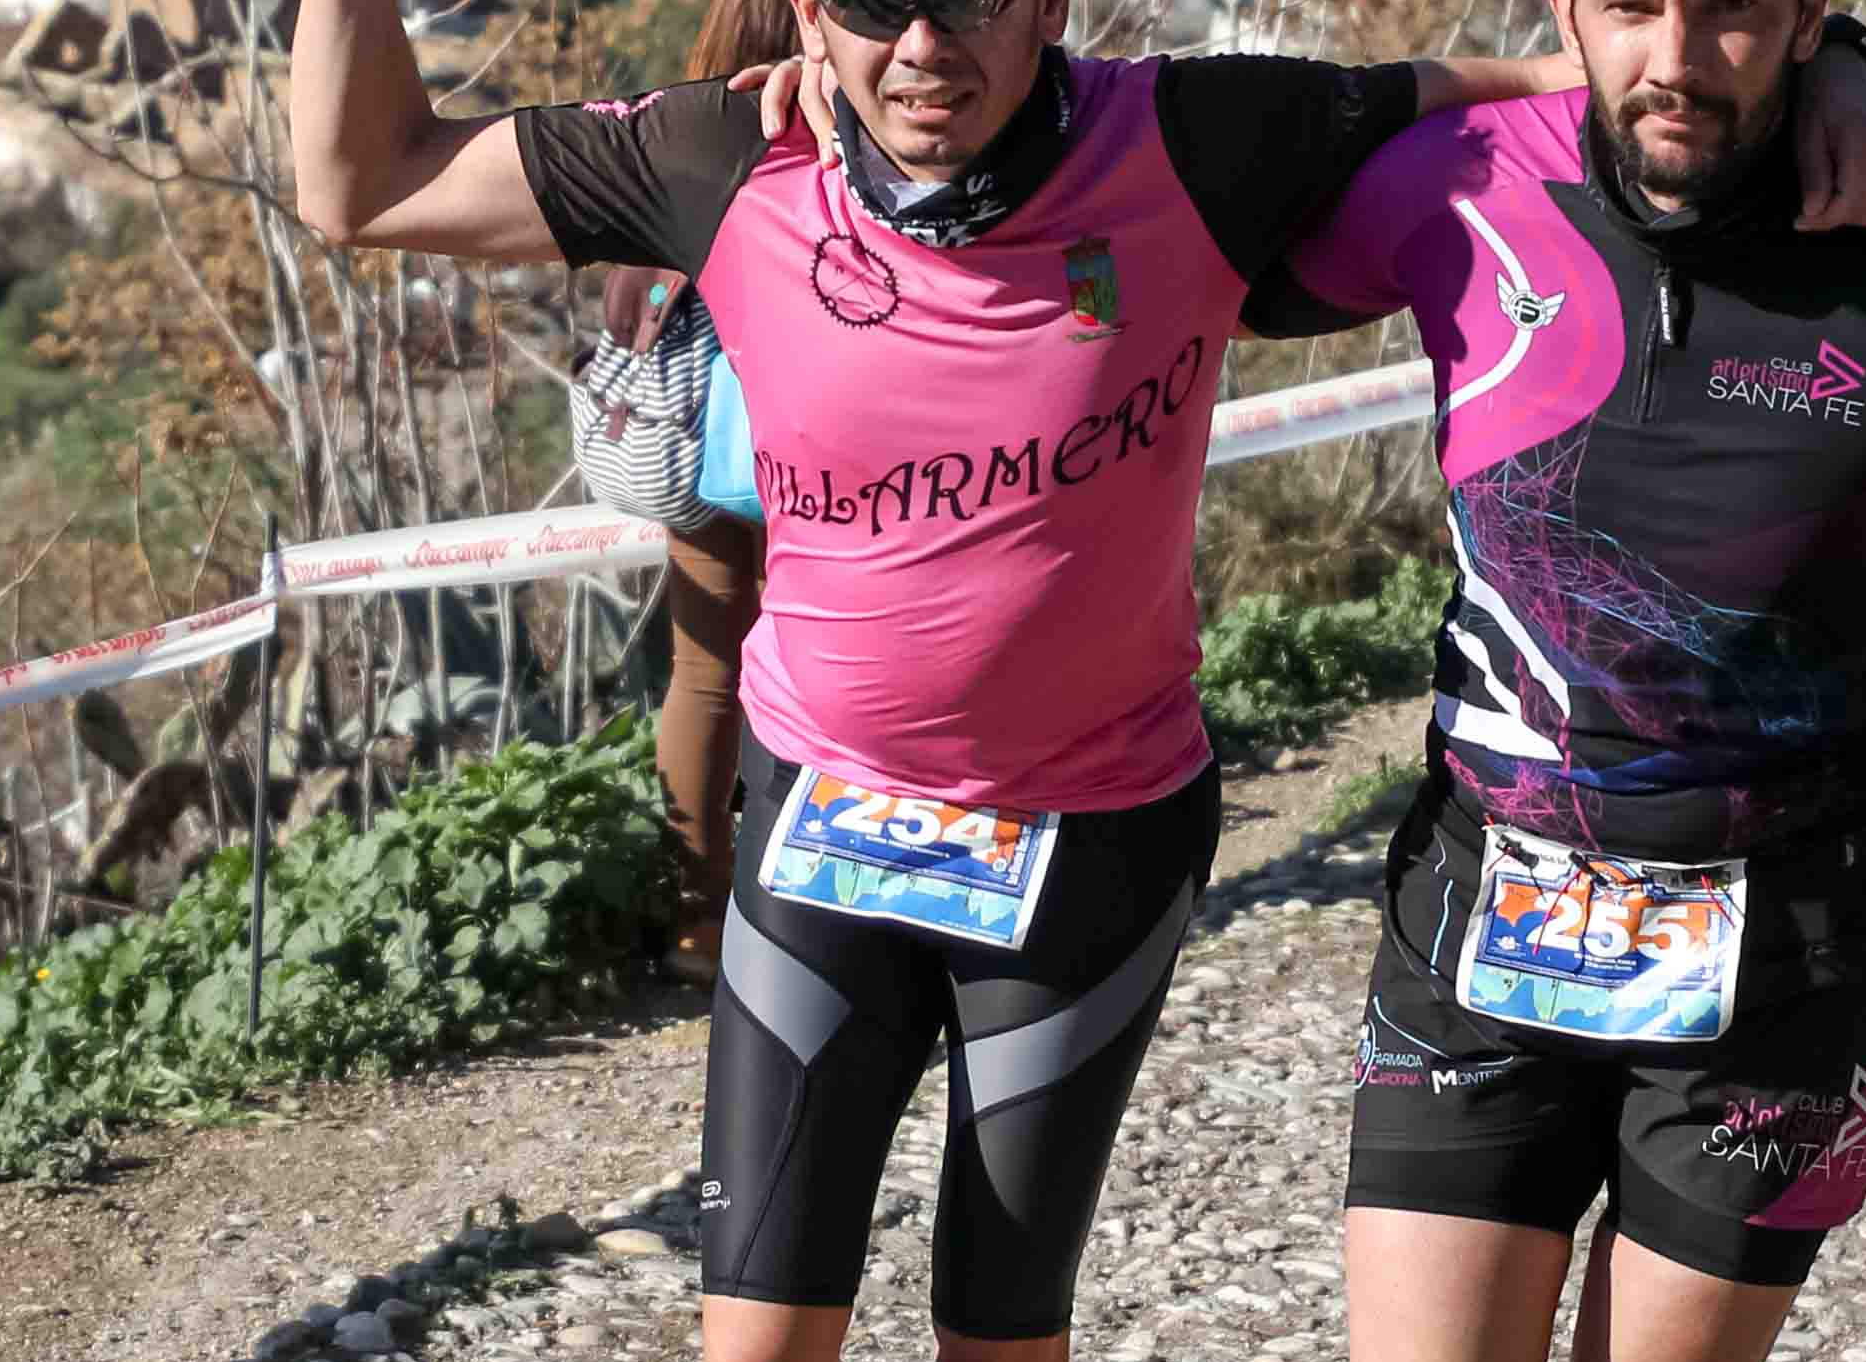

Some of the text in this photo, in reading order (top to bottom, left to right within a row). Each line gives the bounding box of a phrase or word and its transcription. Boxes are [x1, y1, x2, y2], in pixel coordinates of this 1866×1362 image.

[755, 336, 1203, 536] VILLARMERO
[1707, 376, 1865, 427] SANTA FE
[830, 785, 998, 864] 254
[1525, 889, 1694, 961] 255
[1702, 1124, 1831, 1180] SANTA
